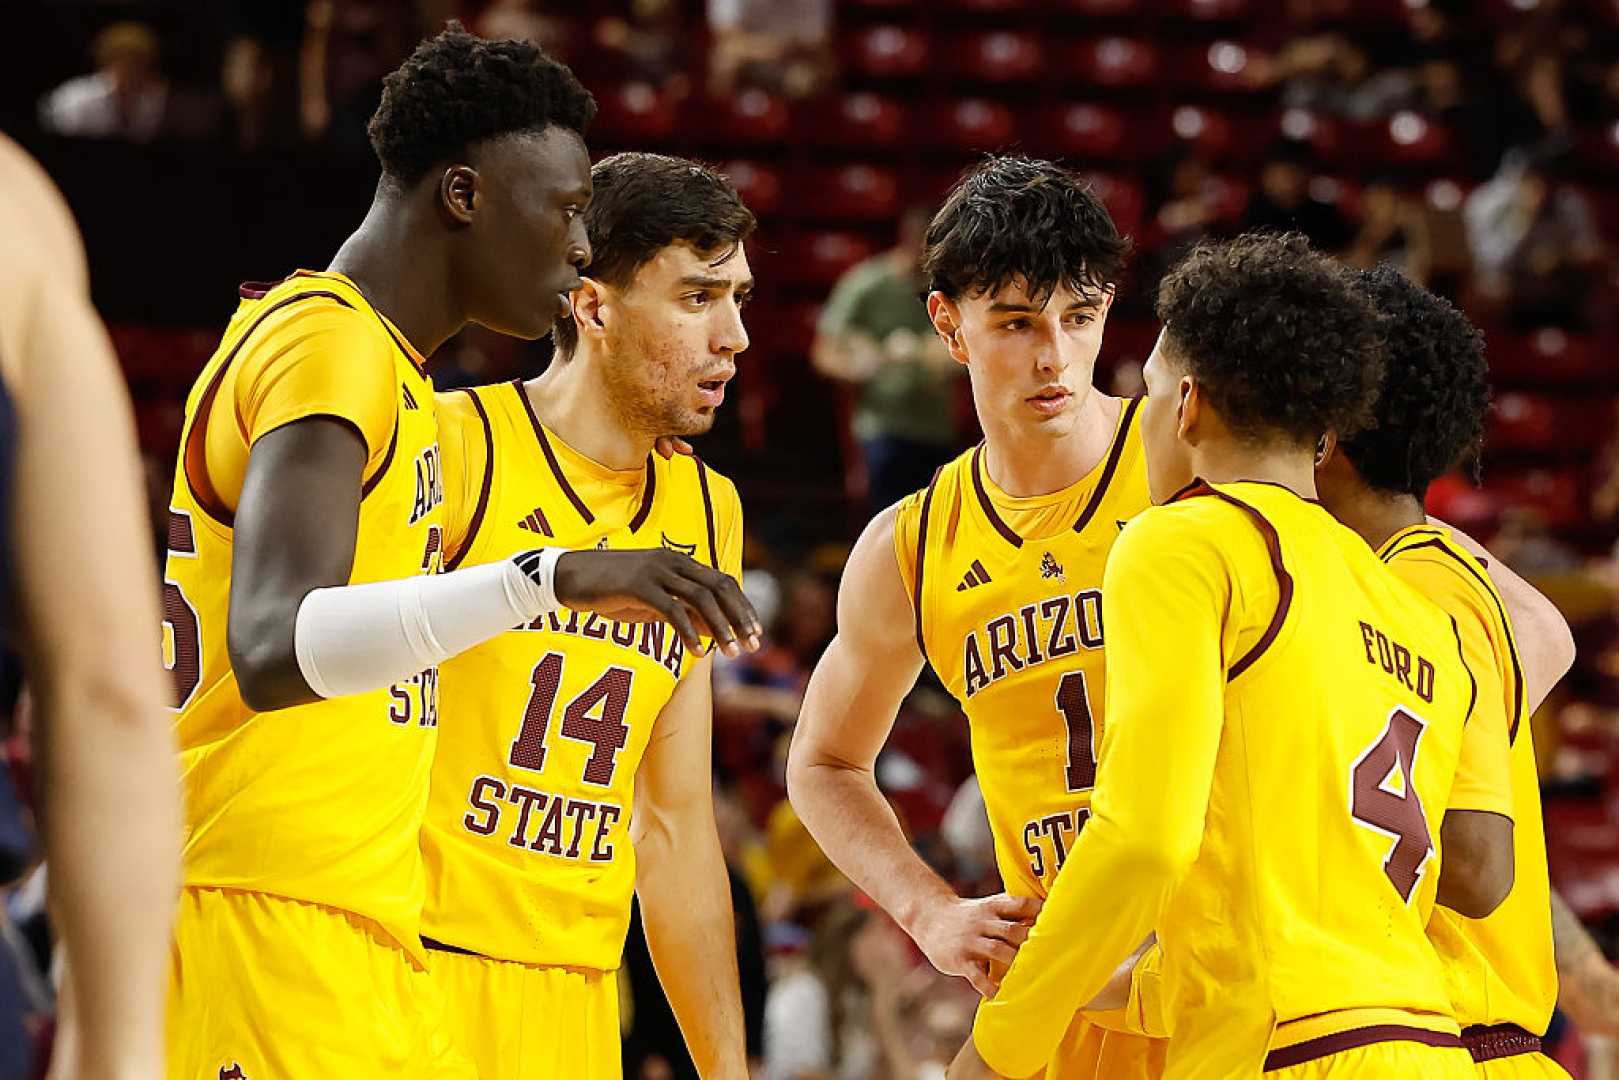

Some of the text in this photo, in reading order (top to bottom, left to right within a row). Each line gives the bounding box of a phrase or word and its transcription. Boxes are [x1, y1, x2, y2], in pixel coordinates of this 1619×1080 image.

[508, 648, 636, 788] 14
[1358, 619, 1436, 705] FORD
[1054, 669, 1097, 793] 1
[463, 774, 622, 863] STATE
[1349, 703, 1436, 906] 4
